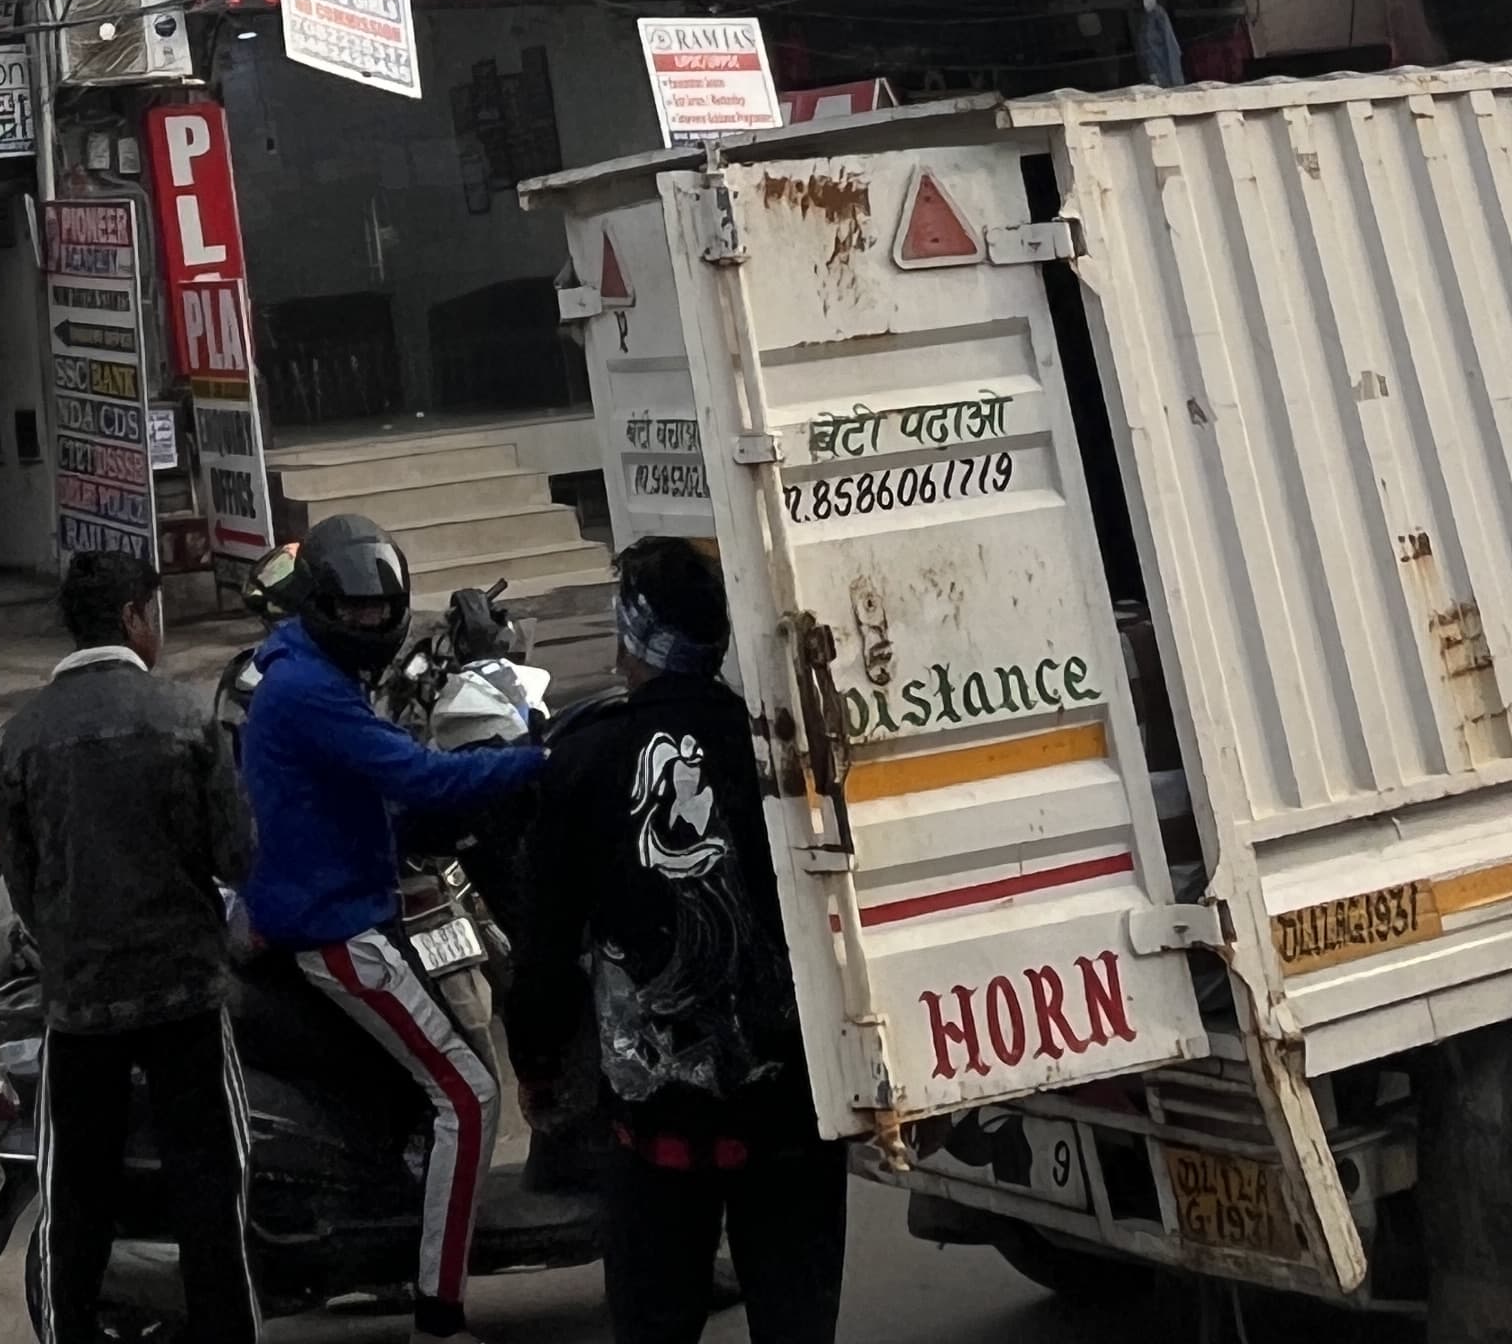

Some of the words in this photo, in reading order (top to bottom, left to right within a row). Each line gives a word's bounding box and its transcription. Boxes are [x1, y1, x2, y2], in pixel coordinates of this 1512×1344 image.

[182, 289, 246, 371] PLA
[55, 358, 87, 390] SSC
[92, 363, 138, 398] BANK
[100, 405, 139, 440] CDS
[809, 403, 882, 459] बेटी
[842, 654, 1101, 738] Distance
[918, 950, 1137, 1080] HORN
